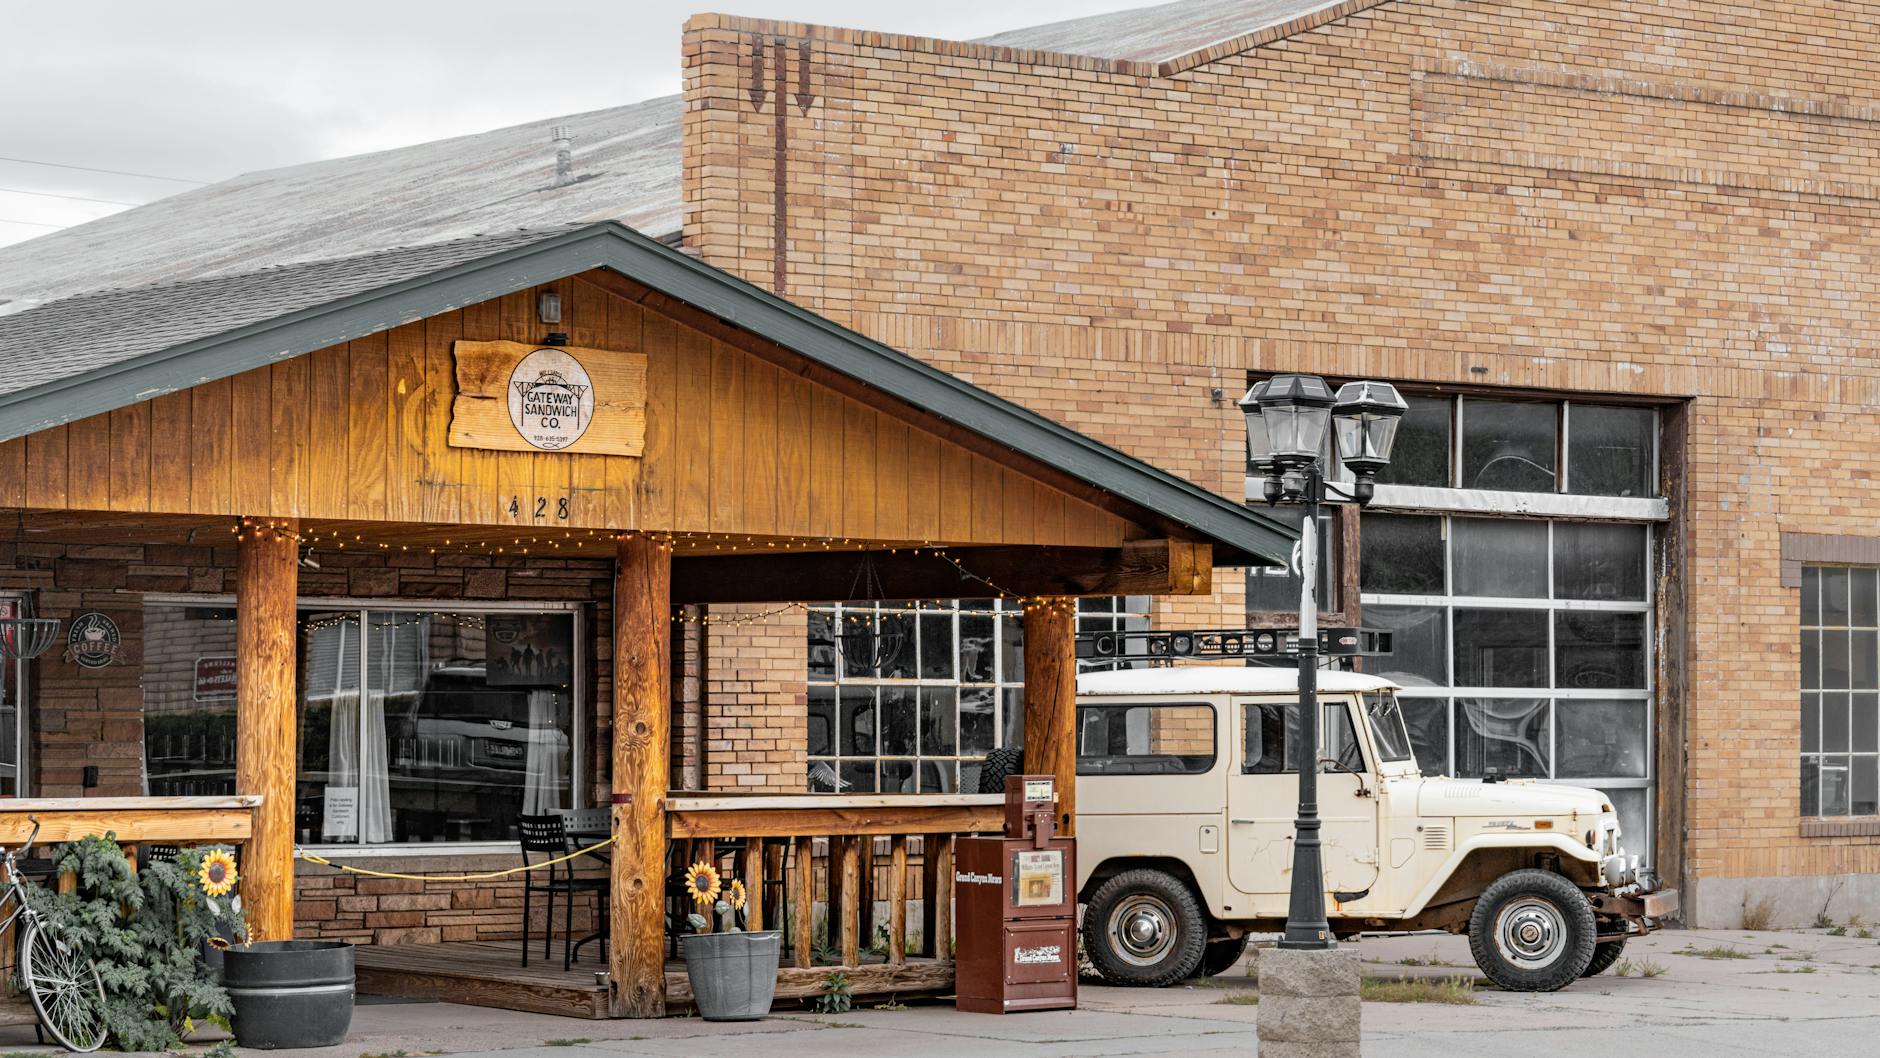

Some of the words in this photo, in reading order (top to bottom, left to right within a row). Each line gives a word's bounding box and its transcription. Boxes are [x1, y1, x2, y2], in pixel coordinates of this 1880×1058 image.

[527, 391, 573, 405] GATEWAY
[525, 404, 577, 417] SANDWICH
[541, 417, 561, 429] CO.
[509, 495, 568, 519] 428
[73, 641, 117, 654] COFFEE
[955, 870, 970, 882] Grand
[970, 871, 988, 885] Canyon
[987, 872, 1002, 884] News
